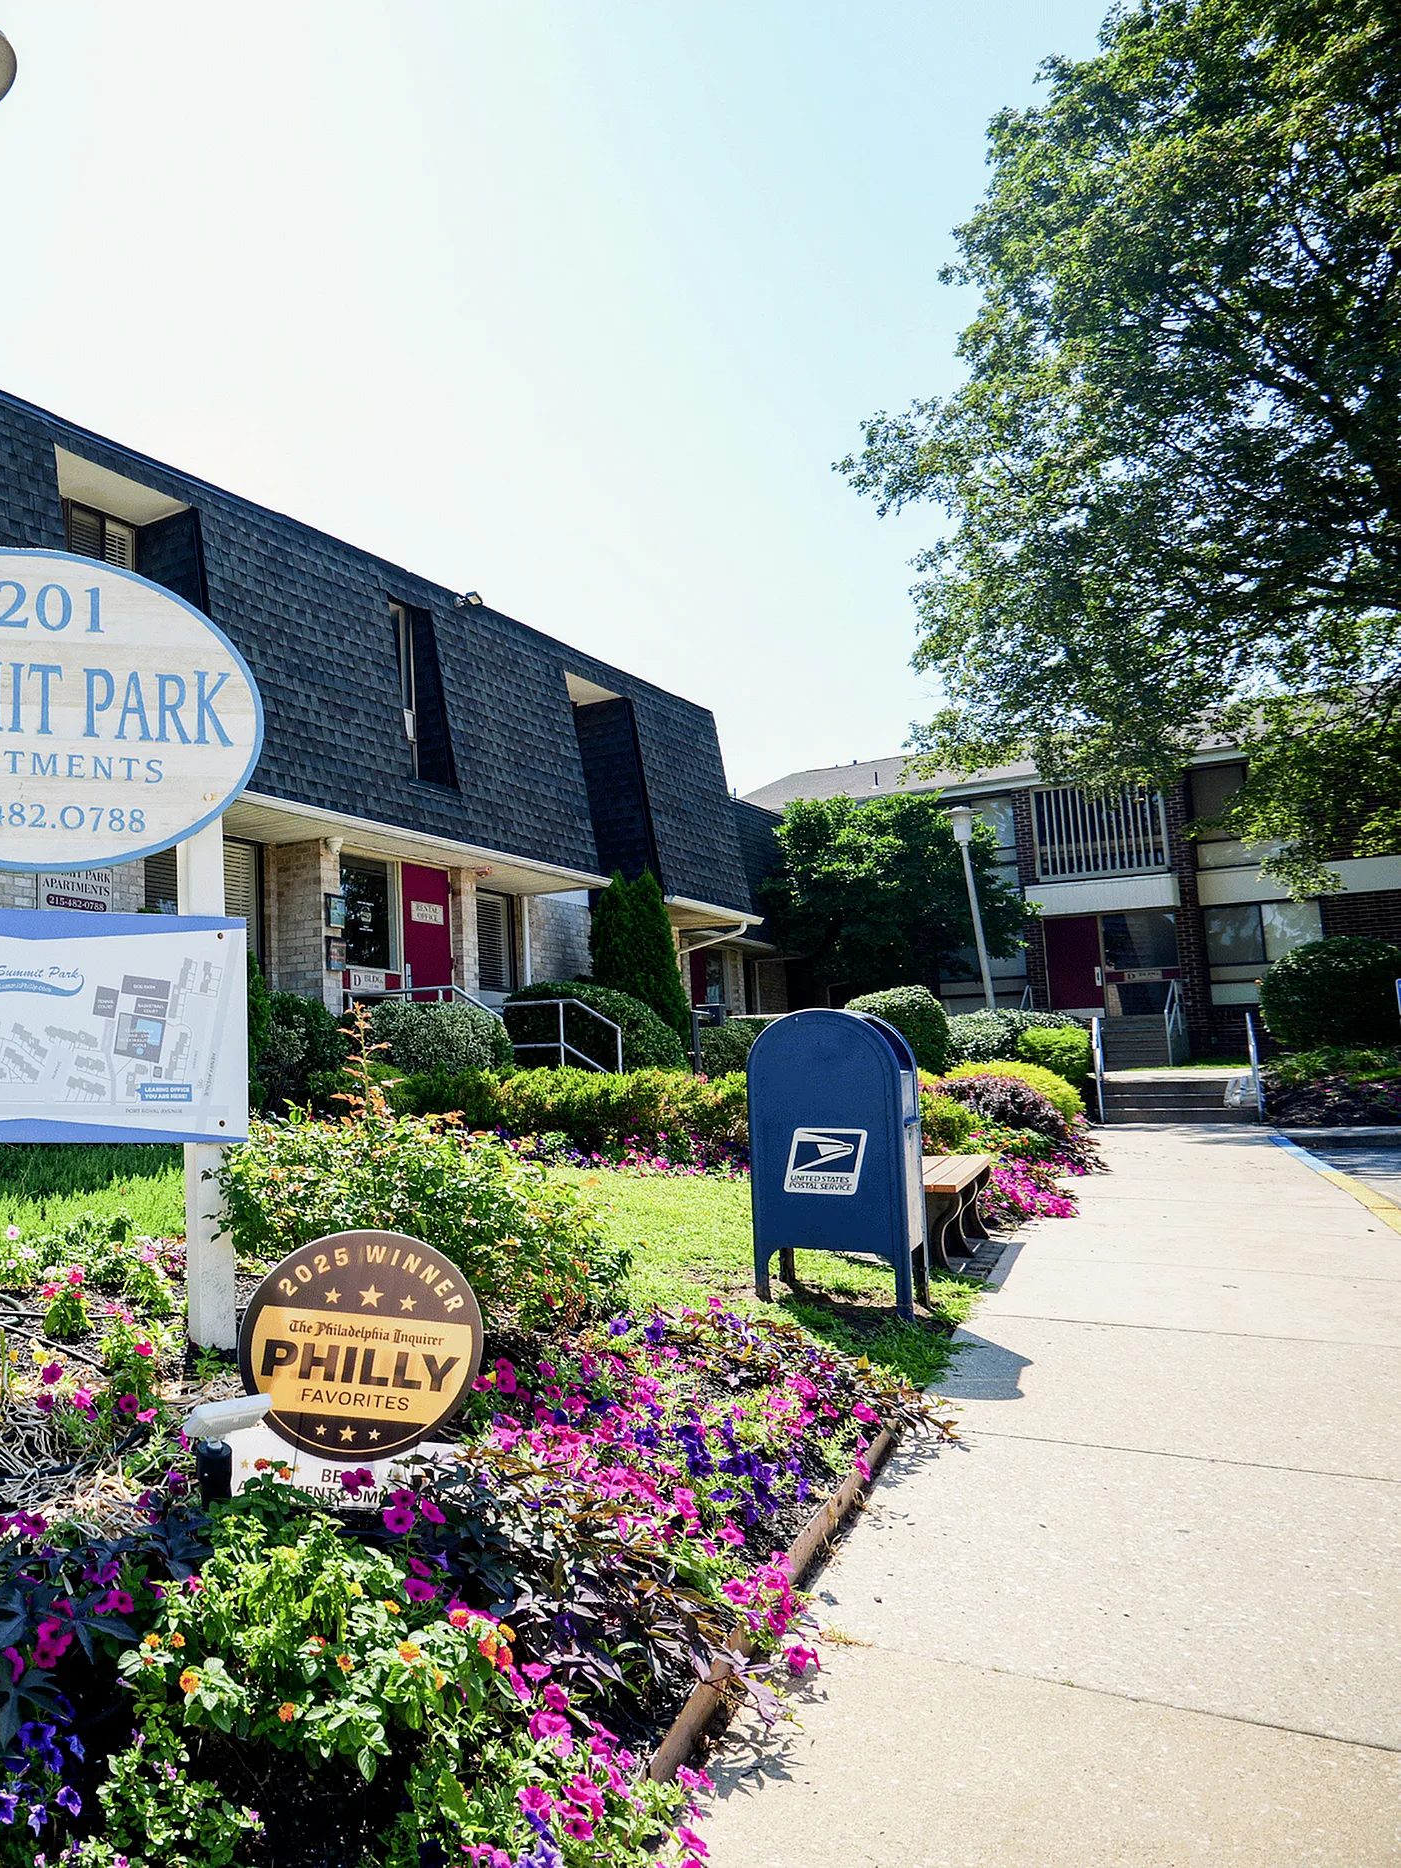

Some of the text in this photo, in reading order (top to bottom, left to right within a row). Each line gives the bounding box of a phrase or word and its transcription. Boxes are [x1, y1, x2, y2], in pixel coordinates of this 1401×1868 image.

[83, 667, 234, 747] PARK
[86, 870, 110, 884] PARK
[43, 878, 110, 896] APARTMENTS
[48, 896, 104, 911] 215-482-0788
[48, 966, 79, 978] Park
[354, 974, 361, 986] D
[820, 1183, 852, 1191] SERVICE
[278, 1244, 464, 1313] 2025 WINNER
[289, 1319, 445, 1348] The Philadelphia Inquirer
[260, 1339, 460, 1392] PHILLY
[301, 1388, 410, 1411] FAVORITES
